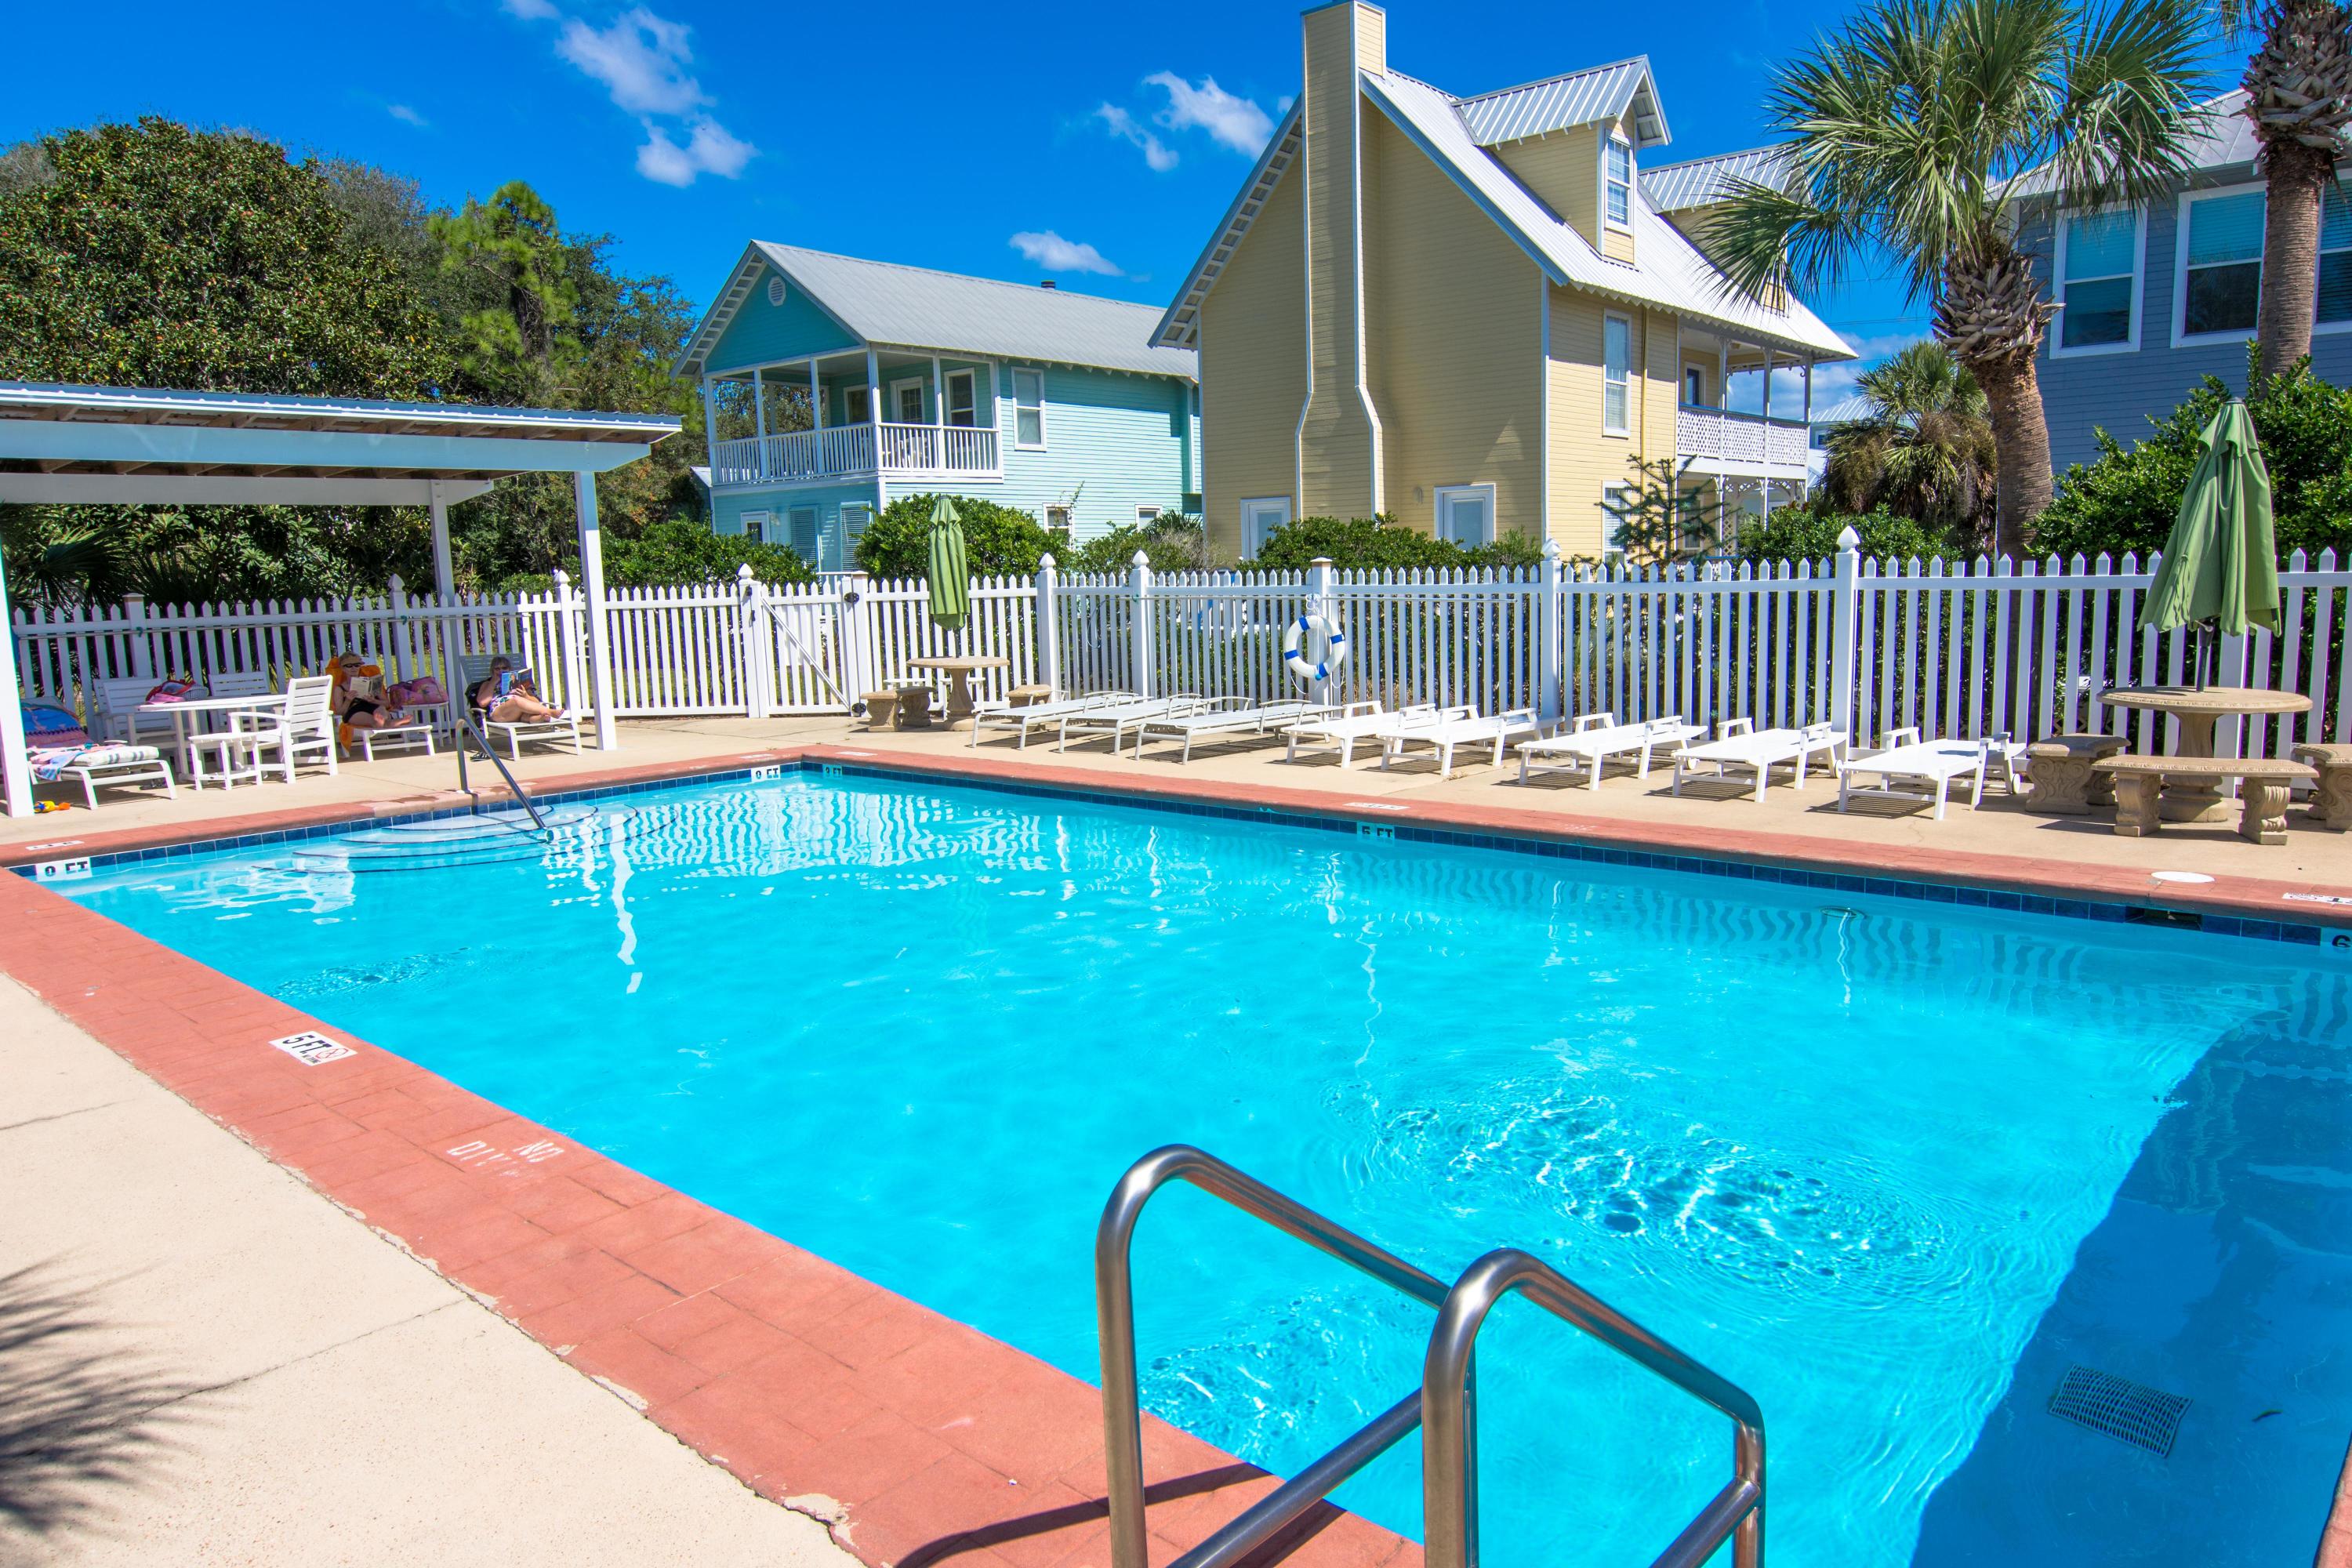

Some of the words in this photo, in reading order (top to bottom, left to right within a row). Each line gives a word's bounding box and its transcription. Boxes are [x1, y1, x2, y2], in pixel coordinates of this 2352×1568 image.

[1377, 827, 1392, 837] FT
[282, 1034, 315, 1044] 5
[513, 1139, 564, 1163] NO
